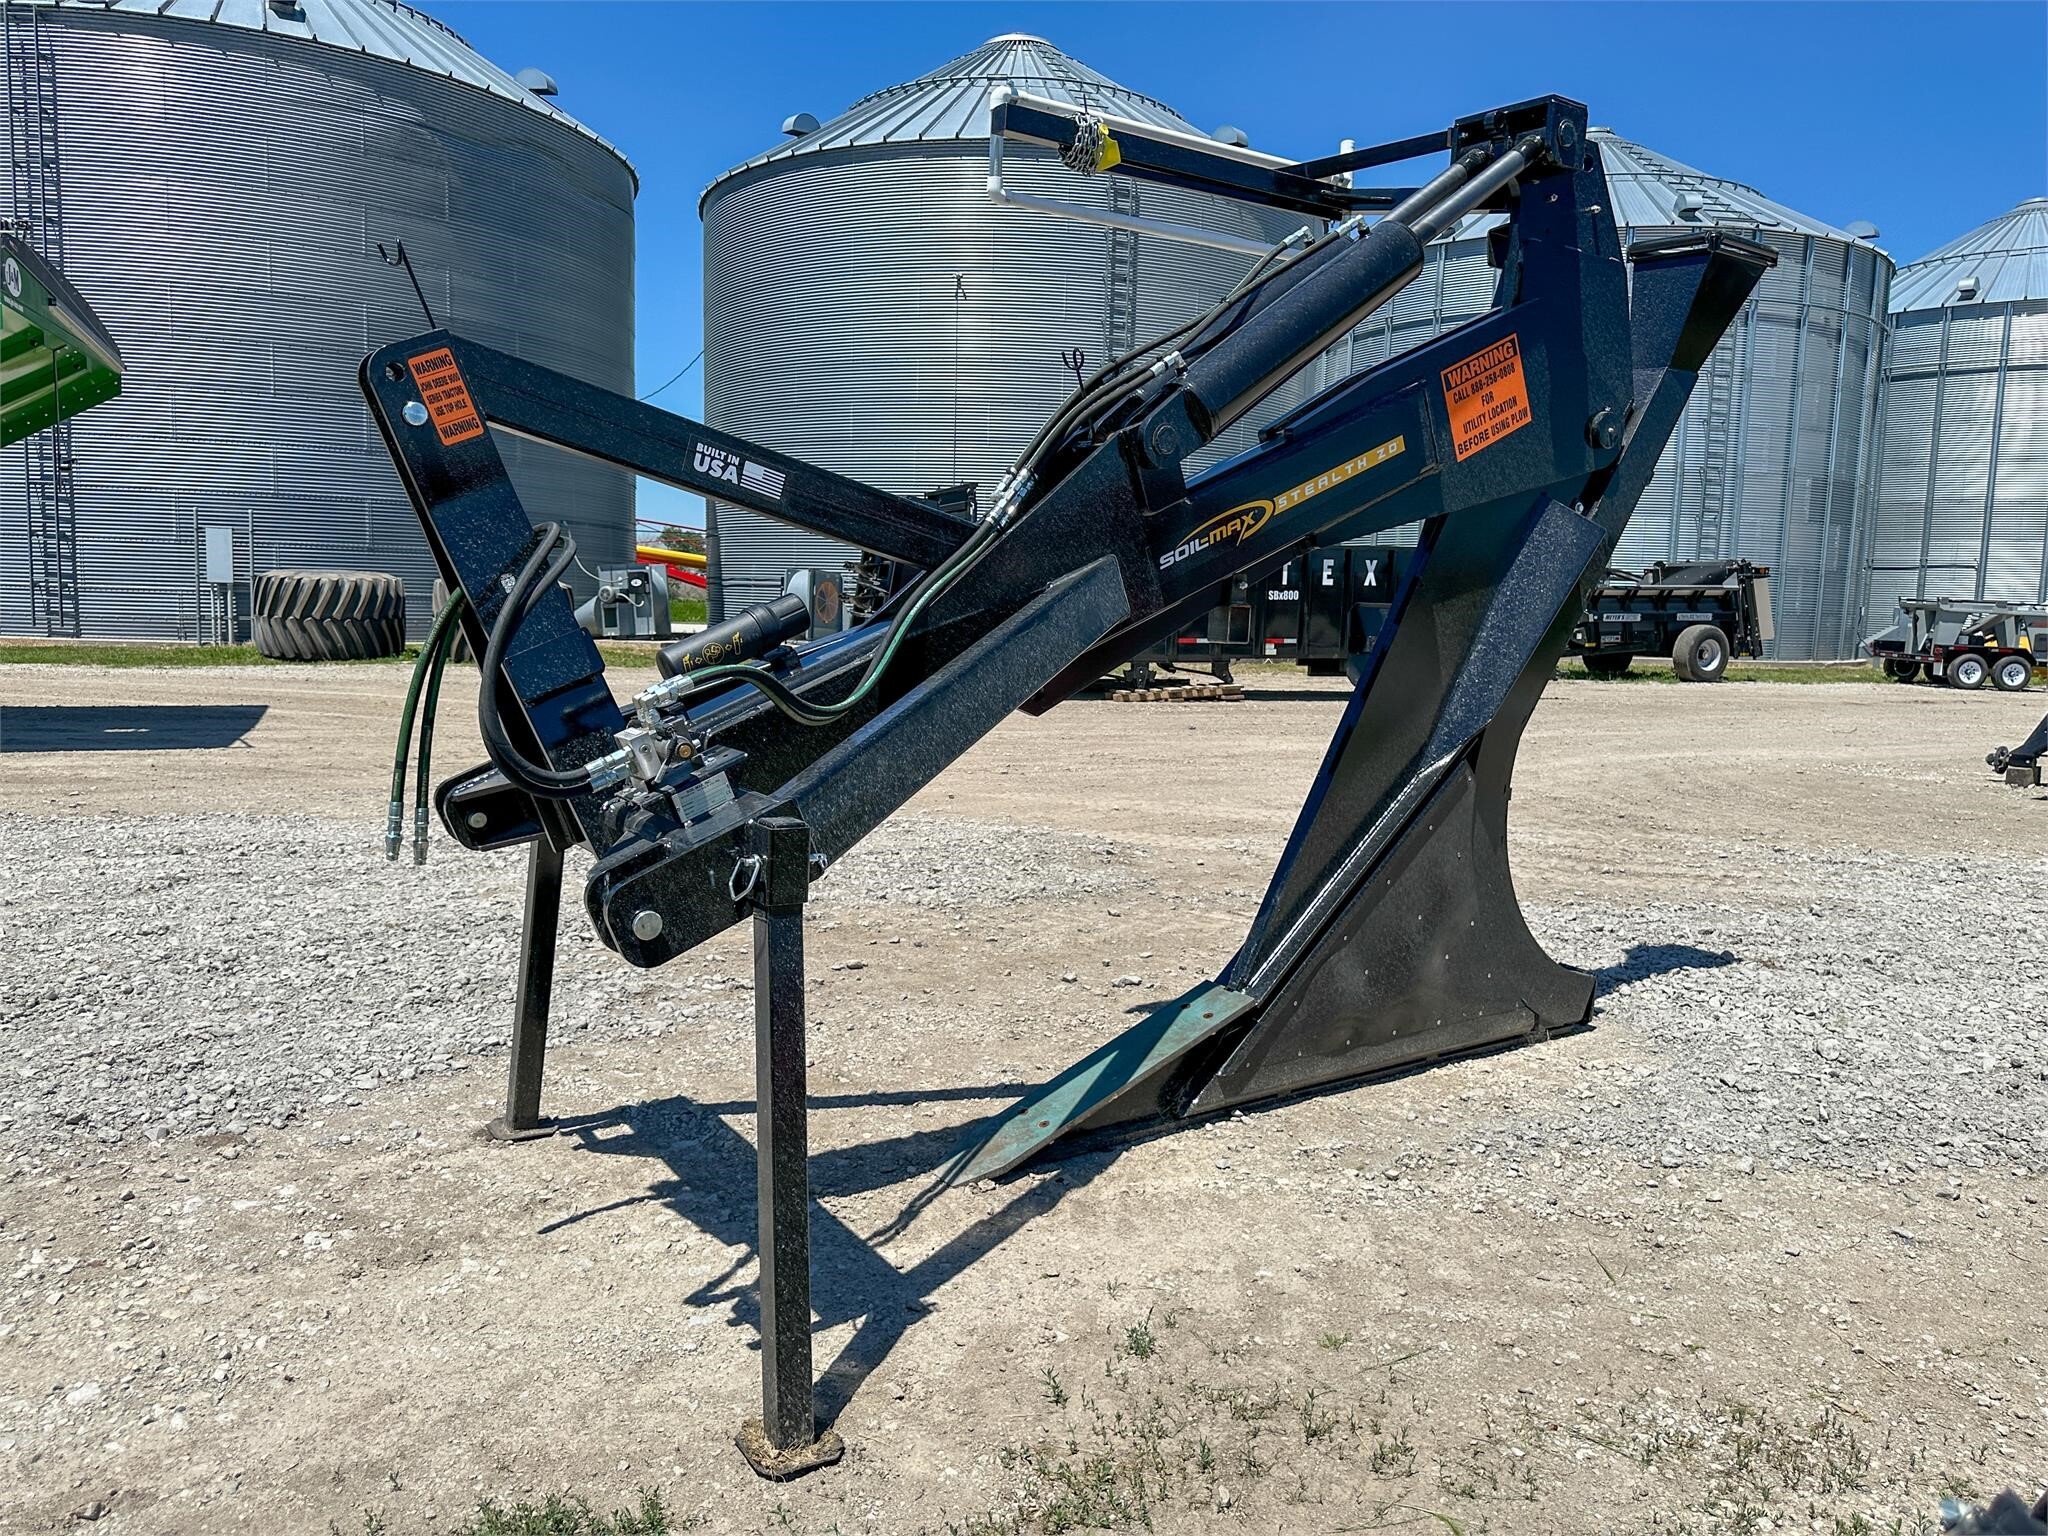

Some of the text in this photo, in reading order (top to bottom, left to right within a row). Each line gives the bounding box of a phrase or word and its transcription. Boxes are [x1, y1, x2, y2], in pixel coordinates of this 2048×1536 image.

[412, 353, 453, 376] WARNING
[1447, 341, 1514, 388] WARNING
[420, 379, 434, 392] JOHN
[432, 375, 449, 388] DEERE
[441, 385, 464, 400] TRACTORS
[1453, 386, 1470, 404] CALL
[1481, 391, 1495, 407] FOR
[434, 399, 468, 416] USE TOP HOLE
[1463, 395, 1518, 434] UTILITY LOCATION
[440, 417, 480, 439] WARNING
[1457, 407, 1528, 455] BEFORE USING PLOW
[696, 442, 740, 466] BUILT IN
[693, 452, 738, 485] USA
[1278, 457, 1367, 508] STEALTH
[1268, 590, 1299, 601] SBx800
